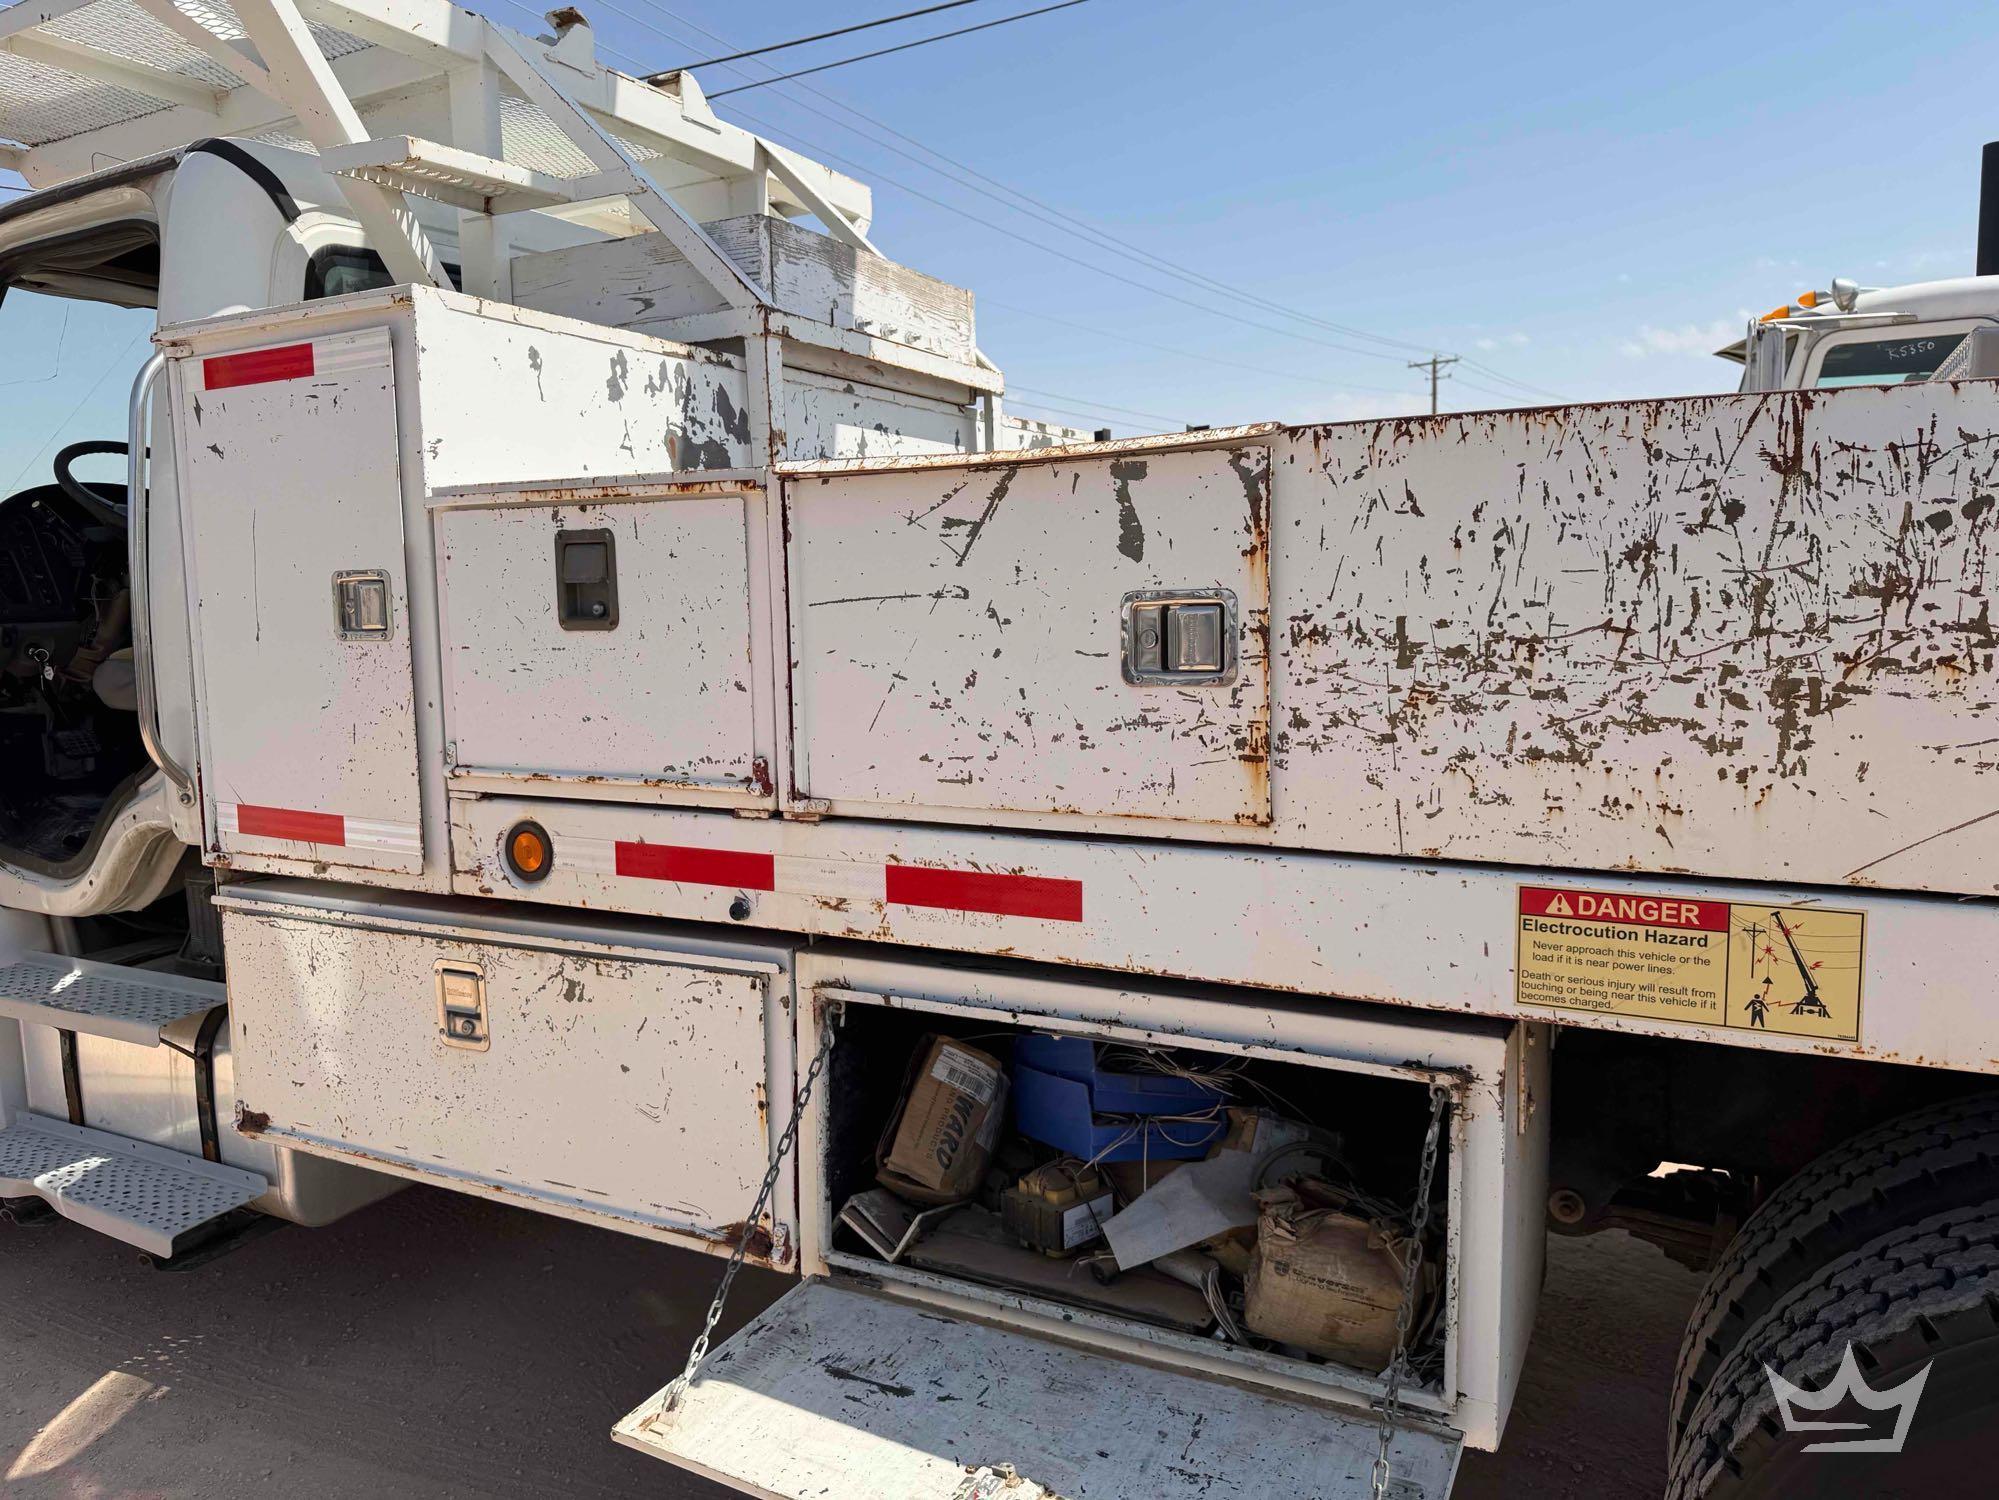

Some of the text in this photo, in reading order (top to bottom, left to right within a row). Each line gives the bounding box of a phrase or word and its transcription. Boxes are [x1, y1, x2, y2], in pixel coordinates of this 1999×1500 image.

[1578, 895, 1700, 925] DANGER
[1522, 918, 1708, 948] Electrocution Hazard
[1532, 940, 1711, 966] Never approach this vehicle or the
[1532, 952, 1675, 975] load if it is near power lines.
[1521, 970, 1551, 980] Death
[1568, 976, 1604, 987] serious
[1608, 979, 1636, 992] injury
[1639, 984, 1656, 992] will
[1658, 986, 1688, 996] result
[1691, 988, 1716, 998] from
[1521, 981, 1563, 994] touching
[1580, 987, 1608, 1000] being
[1611, 992, 1635, 1000] near
[1638, 994, 1656, 1003] this
[1660, 996, 1697, 1008] vehicle
[1700, 1000, 1707, 1008] if
[1710, 1000, 1716, 1010] it
[1521, 991, 1614, 1009] becomes charged.
[936, 1094, 975, 1169] WARD
